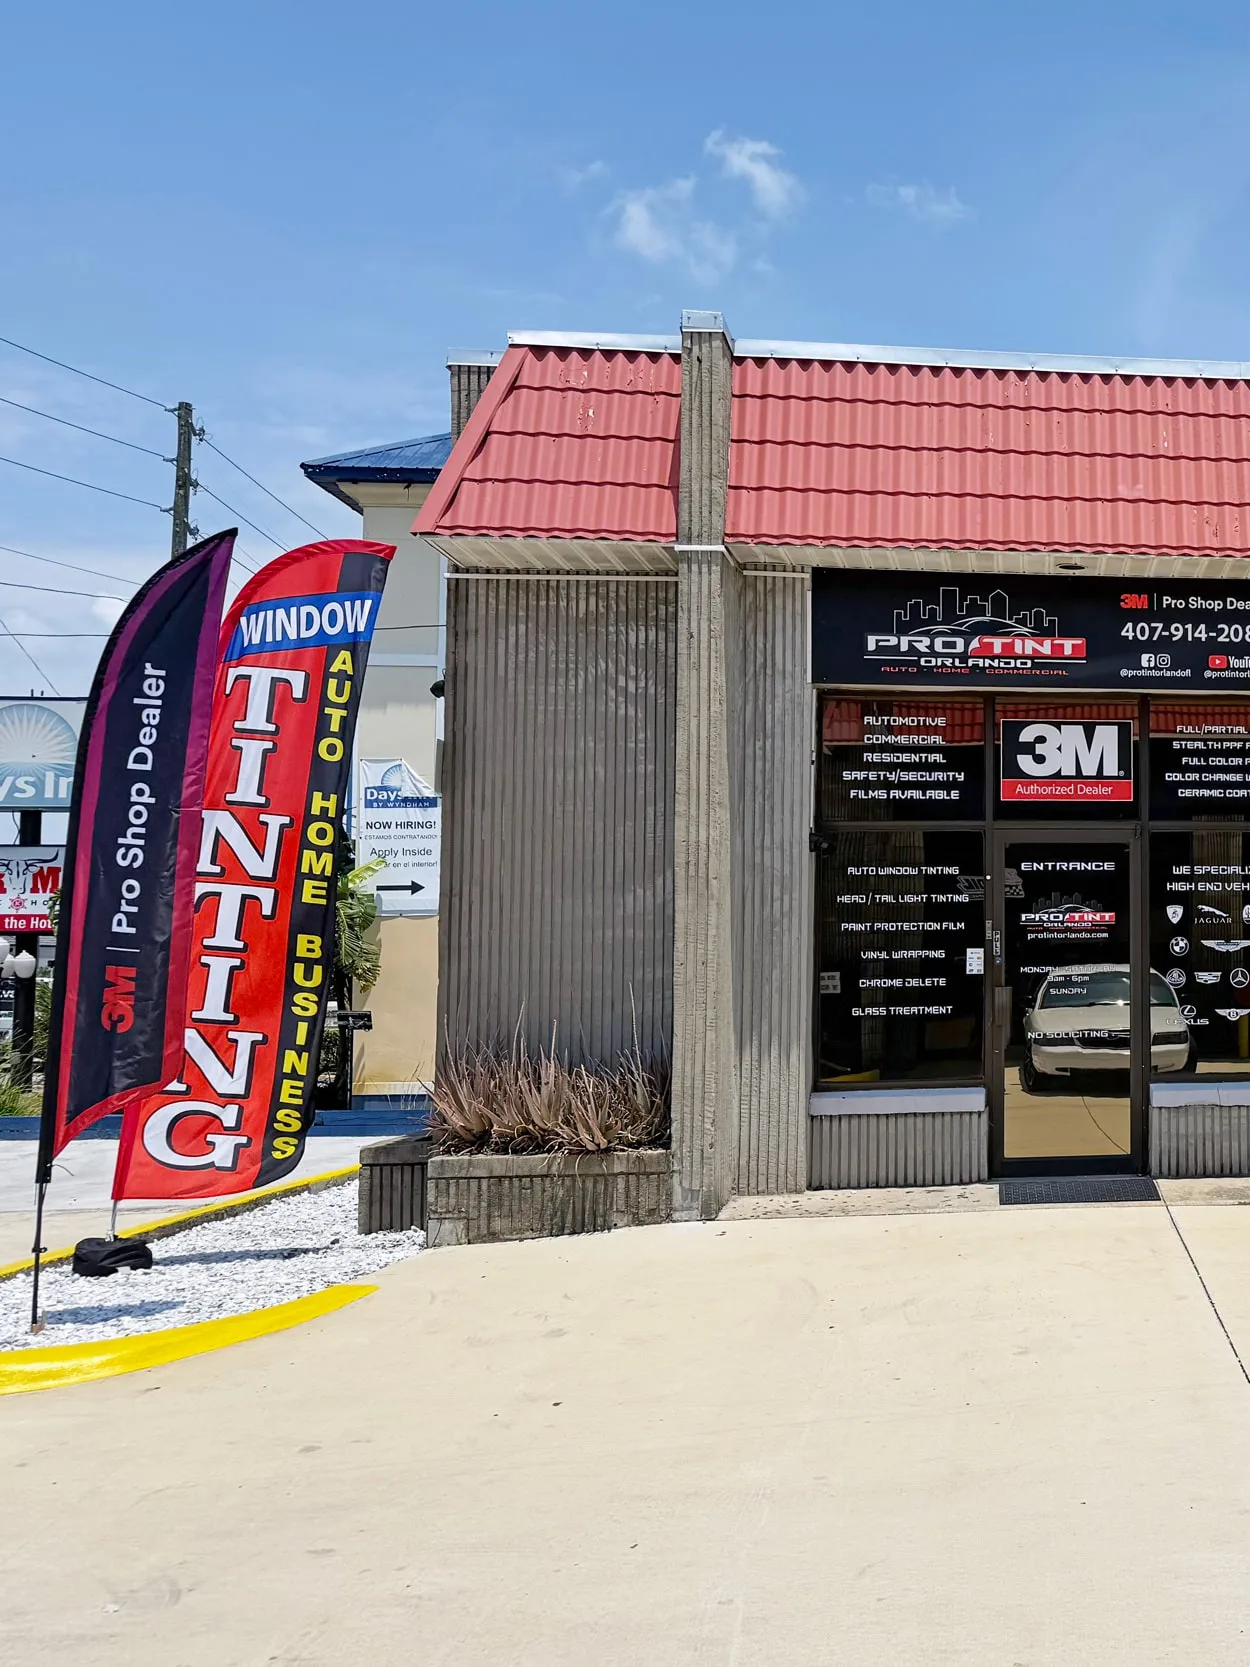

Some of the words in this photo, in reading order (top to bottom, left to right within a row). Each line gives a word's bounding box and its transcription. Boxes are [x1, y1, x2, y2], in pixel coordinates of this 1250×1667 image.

[1120, 593, 1148, 609] 3M
[1162, 596, 1186, 609] Pro
[1188, 597, 1223, 612] Shop
[239, 599, 373, 648] WINDOW
[867, 635, 965, 653] PRO
[982, 638, 1083, 655] TINT
[920, 657, 1032, 668] ORLANDO
[1119, 668, 1192, 678] @protintorlandofl
[317, 650, 354, 763] AUTO
[126, 662, 167, 772] Dealer
[863, 716, 947, 726] AUTOMOTIVE
[1176, 723, 1248, 736] FULL/PARTIAL
[863, 734, 946, 745] COMMERCIAL
[1016, 723, 1119, 777] 3M
[1172, 741, 1221, 749] STEALTH
[1222, 742, 1244, 750] PPF
[863, 752, 947, 763] RESIDENTIAL
[1182, 757, 1207, 765] FULL
[1208, 757, 1243, 766] COLOR
[842, 768, 965, 784] SAFETY/SECURITY
[1165, 773, 1200, 781] COLOR
[1201, 773, 1244, 782] CHANGE
[1015, 783, 1075, 795] Authorized
[1077, 783, 1113, 795] Dealer
[1178, 789, 1225, 797] CERAMIC
[850, 790, 888, 800] FILMS
[889, 790, 960, 800] AVAILABLE
[115, 782, 156, 869] Shop
[366, 821, 392, 830] NOW
[395, 820, 437, 830] HIRING!
[300, 791, 338, 905] HOME
[370, 847, 399, 859] Apply
[402, 847, 433, 857] Inside
[847, 867, 877, 875] AUTO
[878, 867, 919, 875] WINDOW
[920, 866, 960, 875] TINTING
[1020, 862, 1116, 871] ENTRANCE
[1172, 866, 1192, 875] WE
[1166, 882, 1195, 891] HIGH
[1197, 882, 1223, 891] END
[837, 894, 867, 903] HEAD
[874, 894, 897, 903] TAIL
[898, 894, 929, 903] LIGHT
[929, 893, 970, 903] TINTING
[111, 878, 141, 934] Pro
[1021, 913, 1063, 921] PRO
[4, 916, 26, 929] the
[841, 923, 872, 932] PAINT
[874, 922, 941, 931] PROTECTION
[942, 922, 965, 930] FILM
[1027, 932, 1109, 940] protintorlando.com
[860, 950, 891, 959] VINYL
[892, 950, 946, 959] WRAPPING
[859, 979, 904, 988] CHROME
[905, 978, 947, 987] DELETE
[1071, 975, 1090, 983] 6pm
[101, 965, 137, 1034] 3M
[851, 1007, 887, 1016] GLASS
[889, 1006, 953, 1015] TREATMENT
[1027, 1031, 1044, 1039] NO
[1045, 1030, 1109, 1038] SOLICITING
[271, 934, 322, 1160] BUSINESS
